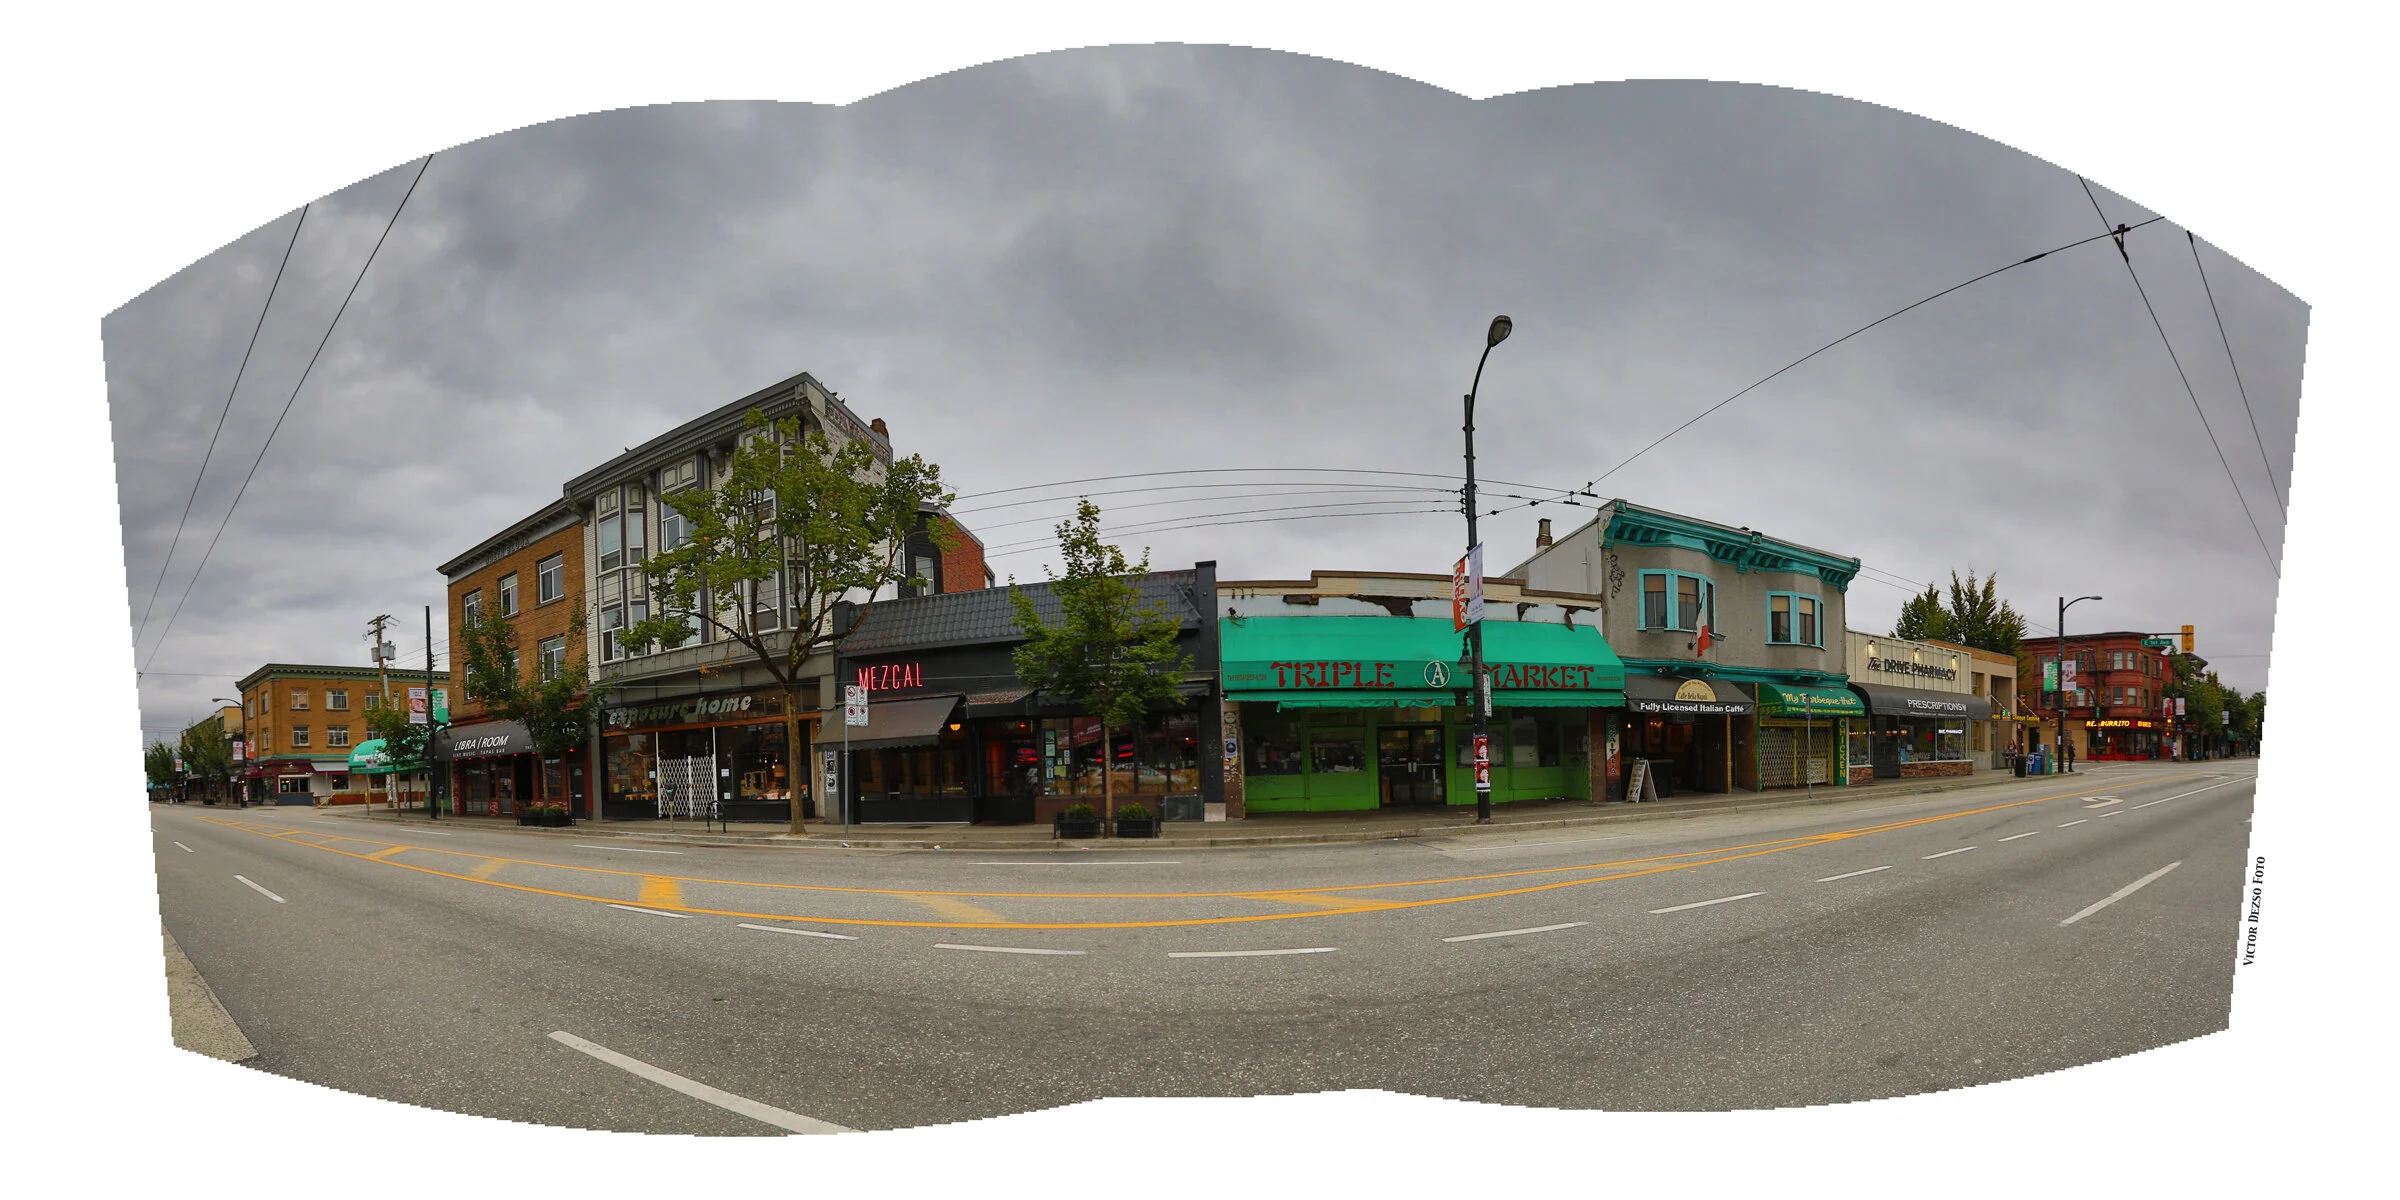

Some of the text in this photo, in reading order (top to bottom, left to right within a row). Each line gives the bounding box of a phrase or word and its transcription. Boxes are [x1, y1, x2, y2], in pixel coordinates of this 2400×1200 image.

[858, 662, 923, 690] MEZCAL
[1270, 661, 1395, 687] TRIPLE
[1482, 664, 1595, 688] MARKET
[1867, 657, 1956, 681] The DRIVE PHARMACY
[1640, 702, 1660, 712] Fully
[1662, 703, 1698, 712] Licensed
[1700, 704, 1723, 712] Italian
[1782, 693, 1798, 703] My
[1907, 699, 1962, 711] PRESCRIPTIONS
[608, 696, 751, 728] exposure home
[454, 735, 509, 751] LIBRA ROOM
